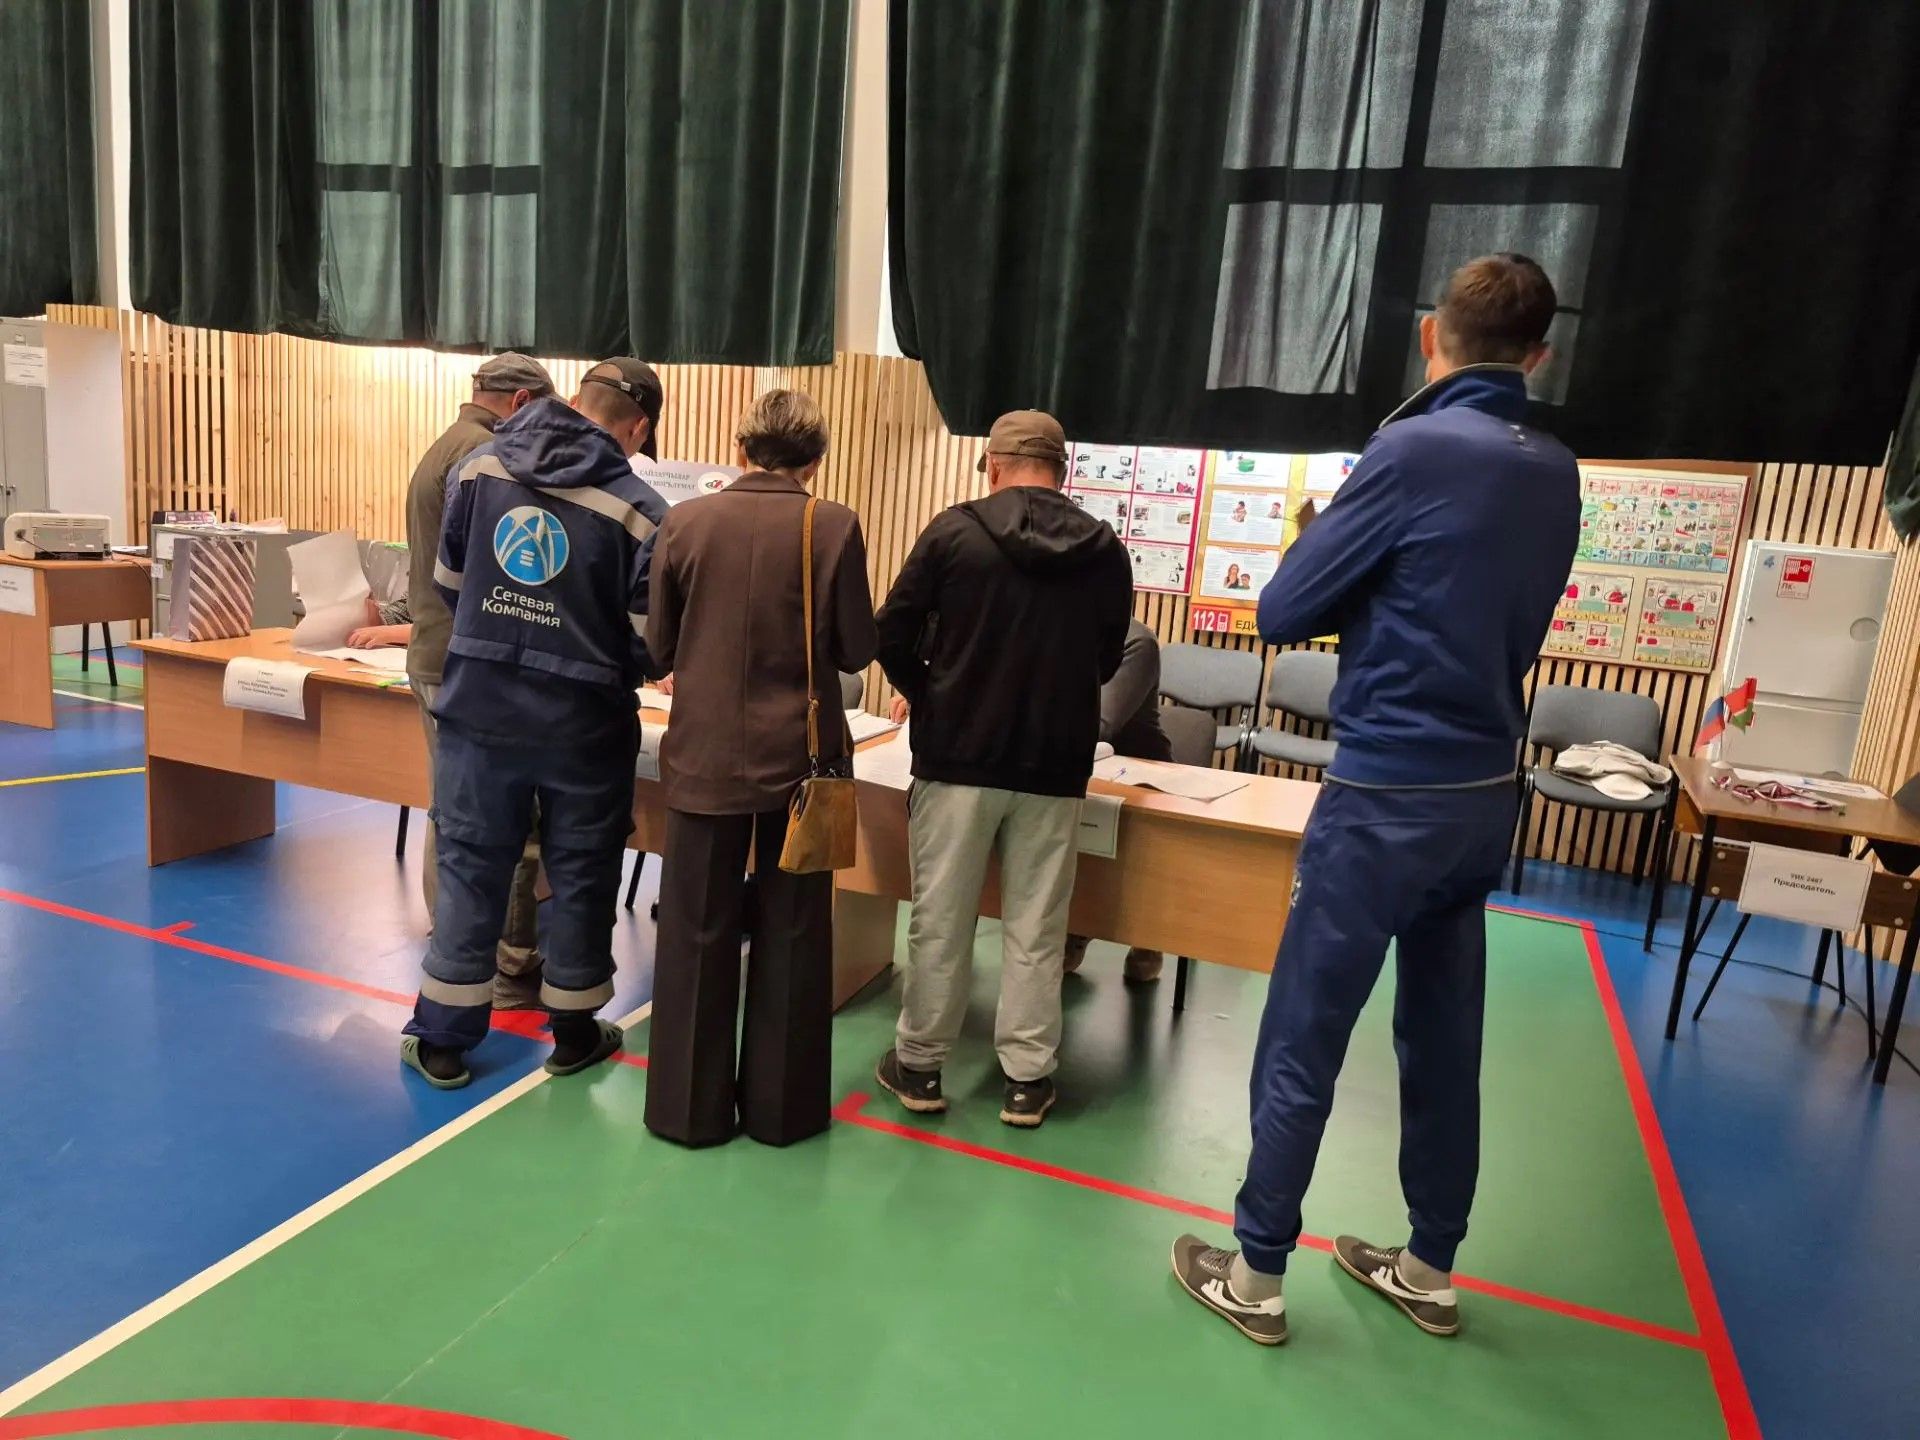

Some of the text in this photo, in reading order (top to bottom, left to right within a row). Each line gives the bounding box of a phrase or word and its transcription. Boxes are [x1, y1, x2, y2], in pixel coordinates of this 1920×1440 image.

[492, 586, 554, 613] Сетевая
[482, 597, 561, 628] Компания
[1193, 610, 1215, 631] 112
[1773, 877, 1837, 896] Председатель
